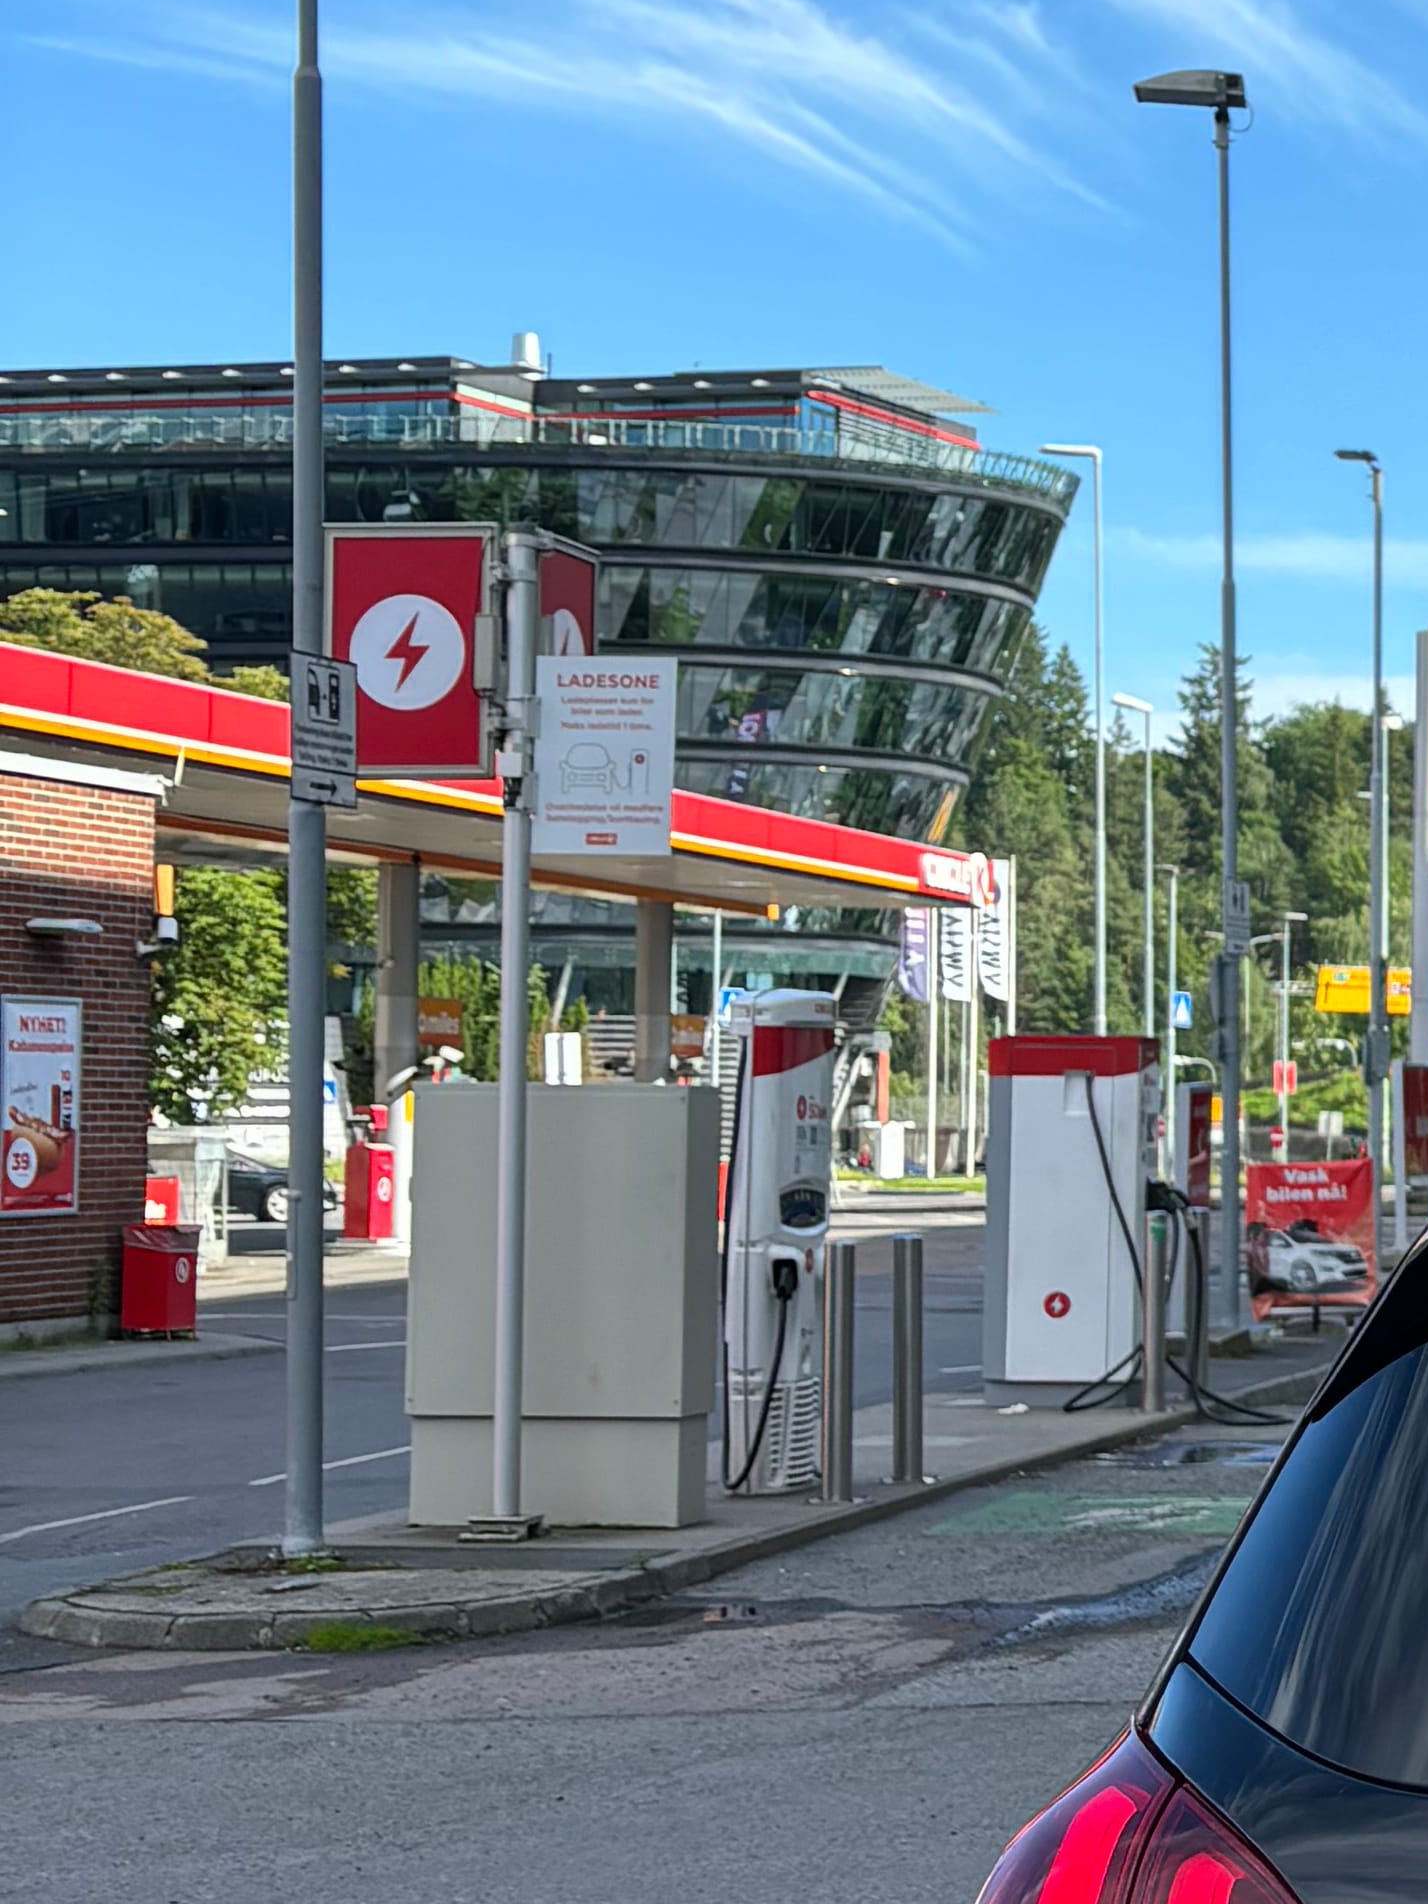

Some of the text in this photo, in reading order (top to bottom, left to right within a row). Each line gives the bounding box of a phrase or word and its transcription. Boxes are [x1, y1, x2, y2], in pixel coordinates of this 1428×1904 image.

[556, 673, 660, 689] LADESONE
[1283, 1167, 1329, 1184] Vask
[1265, 1182, 1348, 1202] bilen nå!
